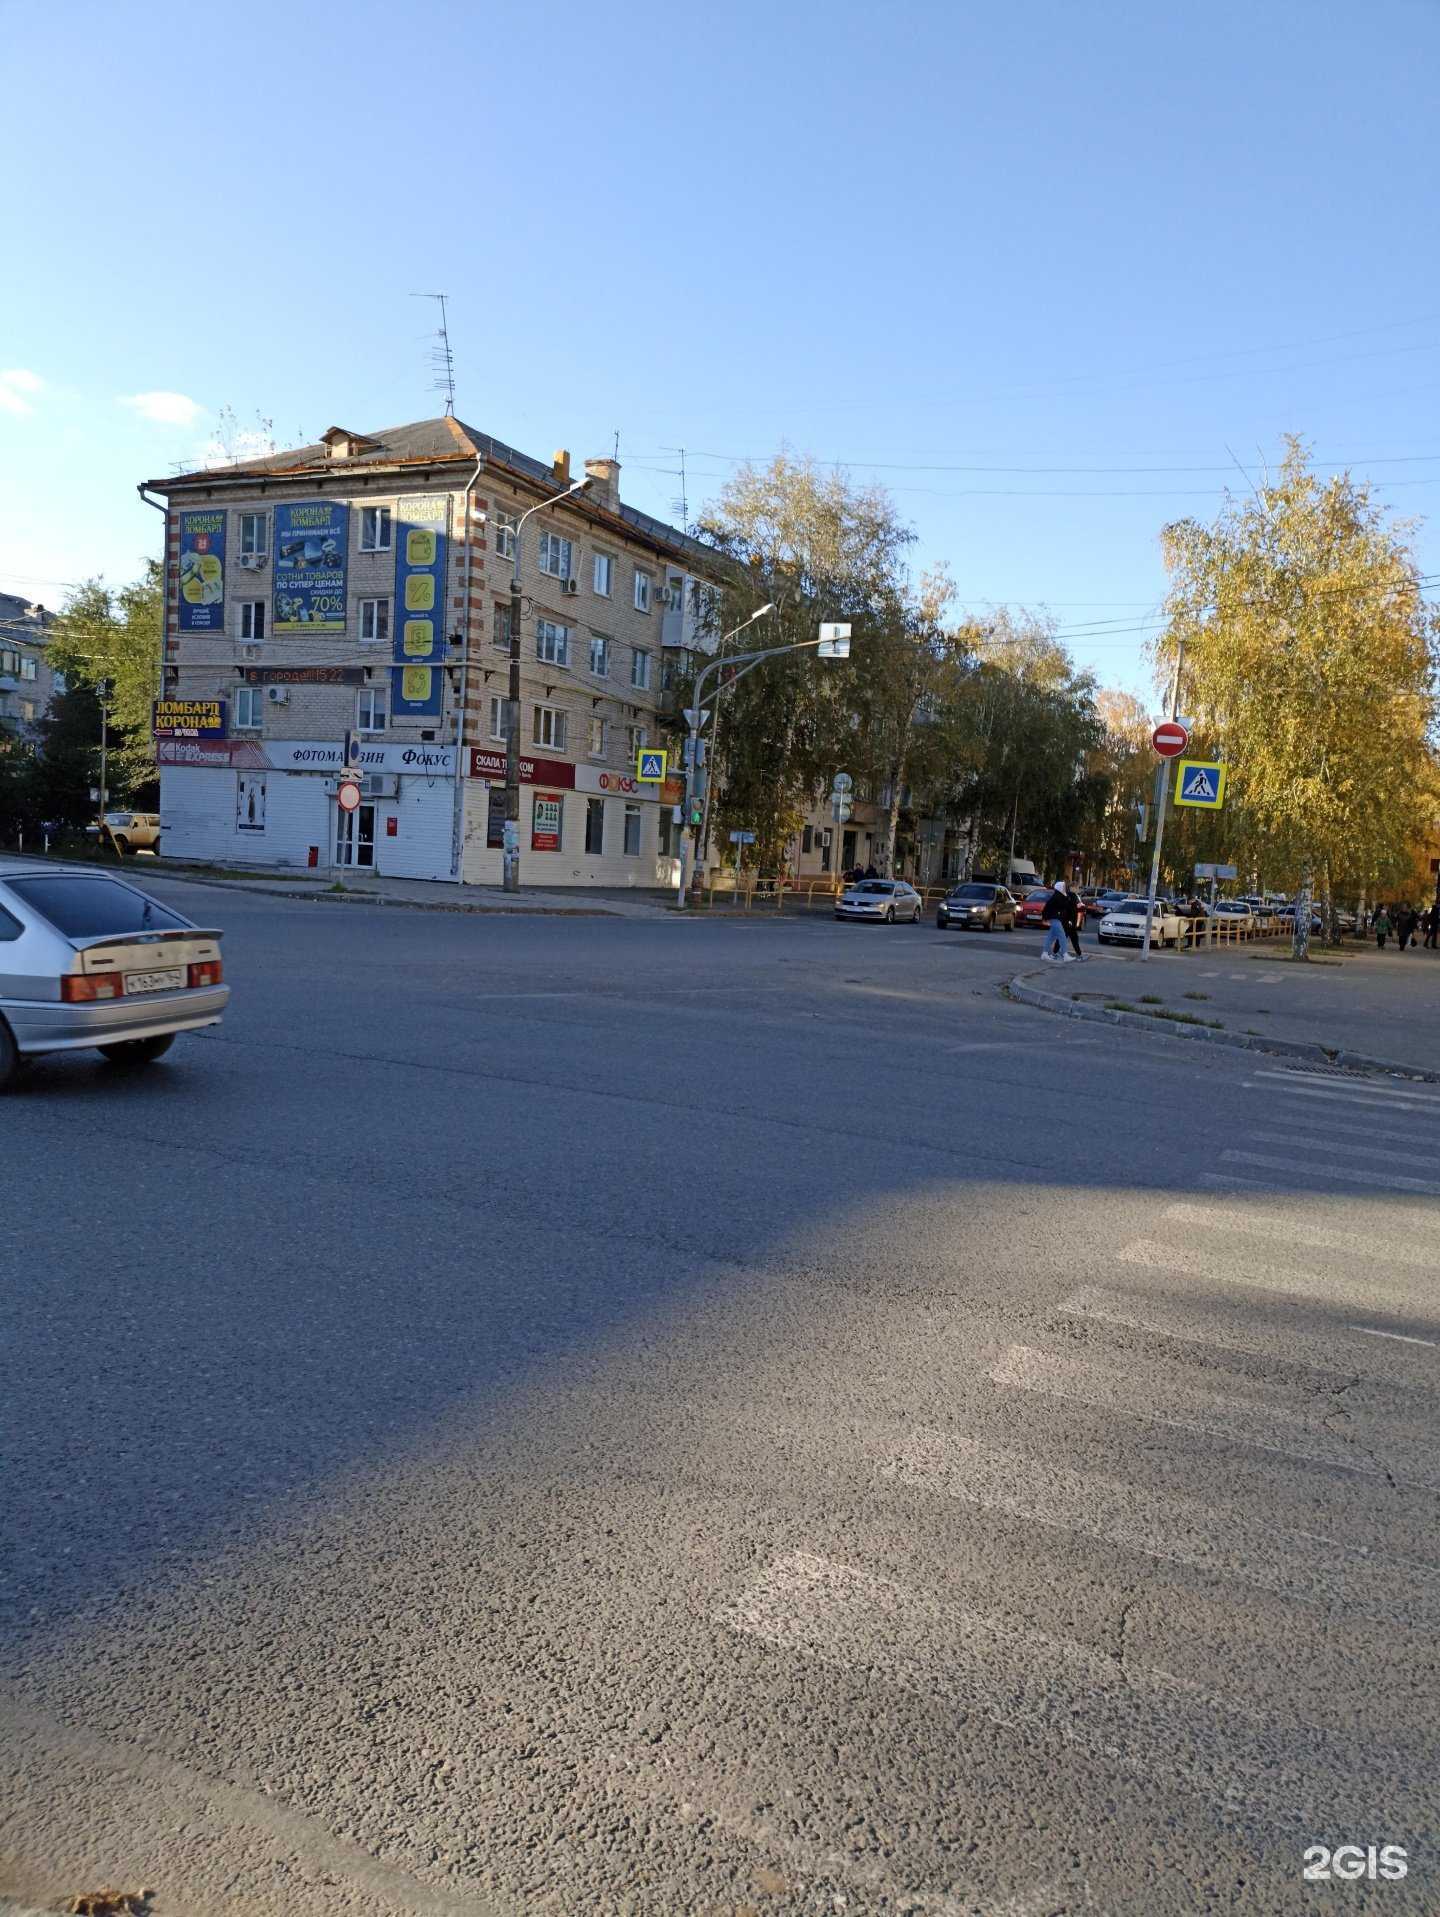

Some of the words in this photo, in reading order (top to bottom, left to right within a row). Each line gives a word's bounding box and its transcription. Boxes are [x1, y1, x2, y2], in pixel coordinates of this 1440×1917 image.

[185, 524, 222, 534] ЛОМБАРД
[291, 516, 330, 528] ЛОМБАРД
[305, 570, 343, 580] ТОВАРОВ
[276, 581, 288, 589] ПО
[289, 580, 314, 589] СУПЕР
[315, 579, 343, 588] ЦЕНАМ
[311, 596, 343, 612] 70%
[155, 701, 220, 716] ЛОМБАРД
[156, 714, 209, 728] КОРОНА
[175, 742, 200, 752] Kodak
[293, 750, 384, 764] ФОТОМАЗИН
[476, 754, 501, 769] СКАЛА
[501, 758, 534, 773] ТКОМ
[599, 773, 639, 794] ФОКУС
